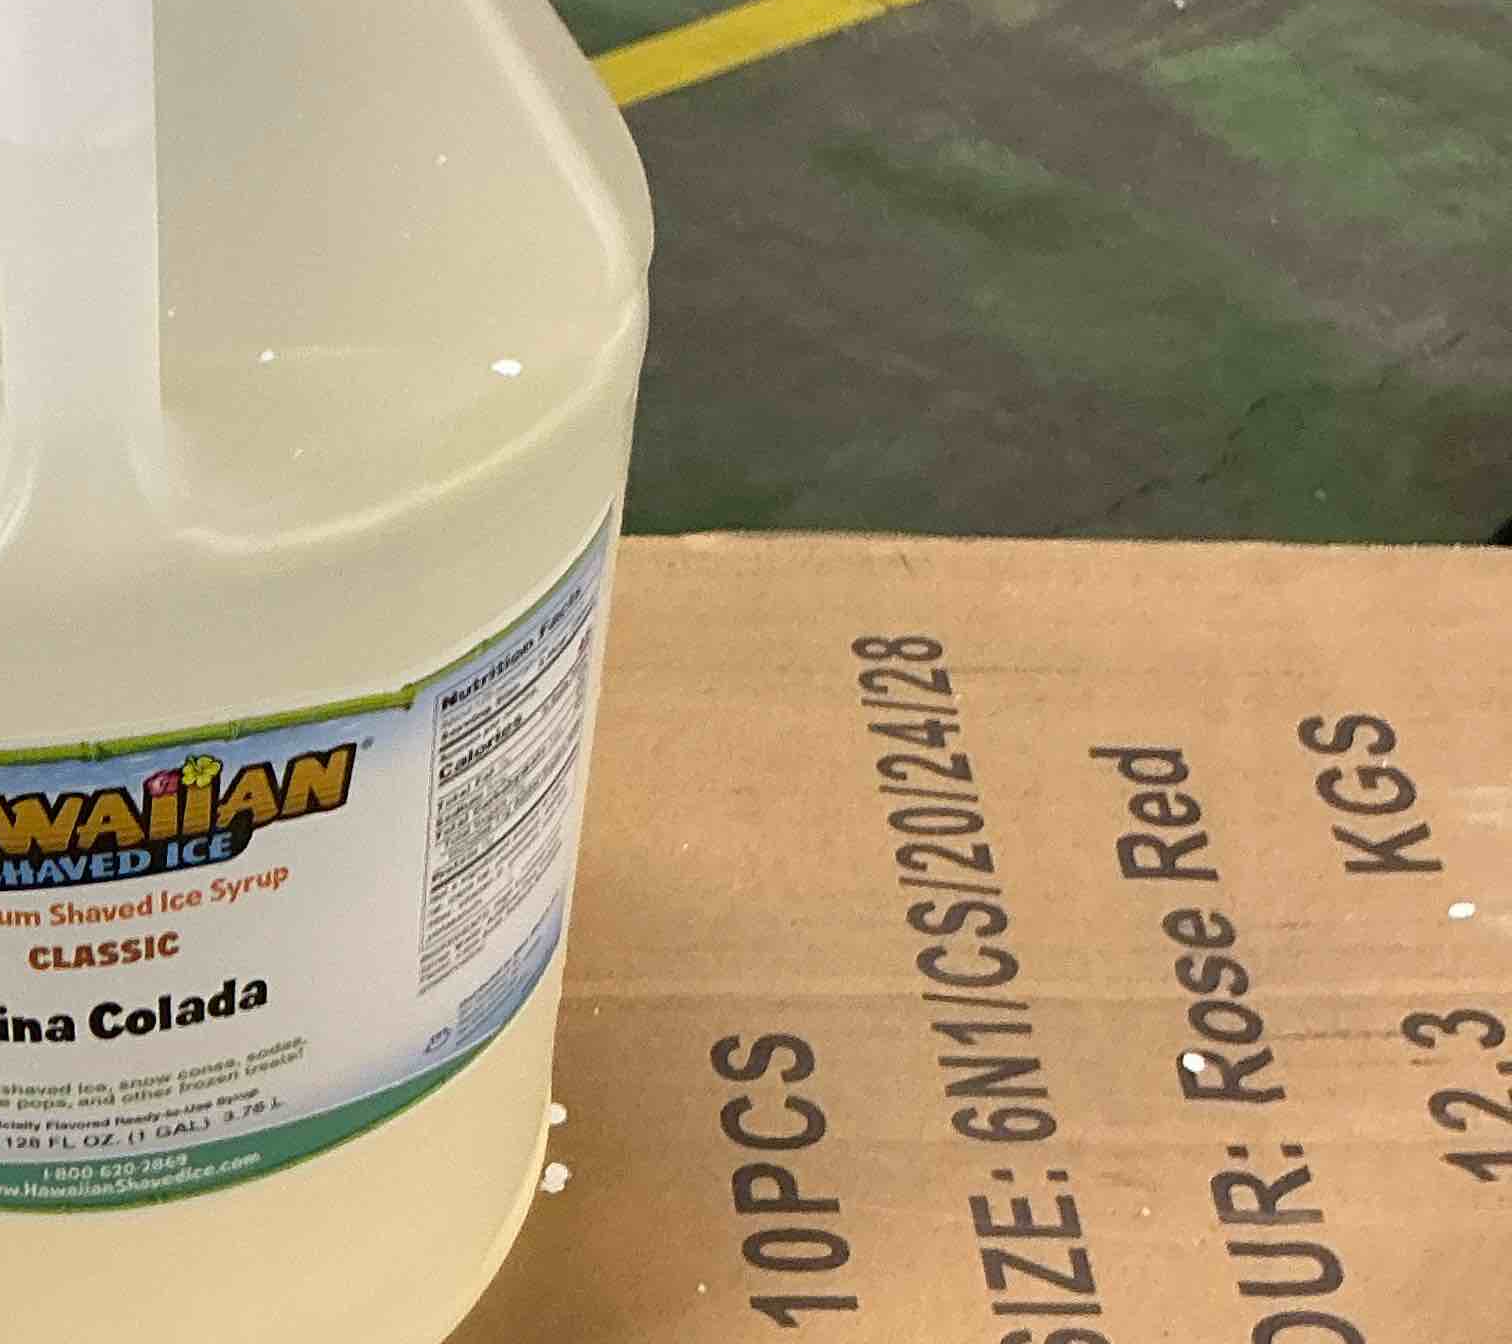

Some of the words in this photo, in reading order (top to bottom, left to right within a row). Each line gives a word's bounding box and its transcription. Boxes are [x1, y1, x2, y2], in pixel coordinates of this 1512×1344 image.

[439, 715, 522, 780] Calories
[1089, 745, 1220, 883] Red
[1298, 712, 1444, 874] KGS
[167, 832, 234, 863] ICE
[51, 895, 153, 927] Shaved
[161, 883, 203, 913] Ice
[210, 864, 290, 905] Syrup
[850, 634, 1058, 1145] 6N1/CS/20/24/28
[28, 931, 181, 971] CLASSIC
[88, 979, 269, 1040] Colada
[1162, 906, 1286, 1104] Rose
[2, 1081, 71, 1096] shaved
[119, 1074, 172, 1091] snow
[78, 1093, 115, 1107] and
[121, 1086, 172, 1105] other
[178, 1070, 239, 1096] frozen
[7, 1134, 40, 1149] 128
[49, 1135, 76, 1150] FL
[46, 1117, 110, 1132] Flavored
[709, 1031, 859, 1329] 10PCS
